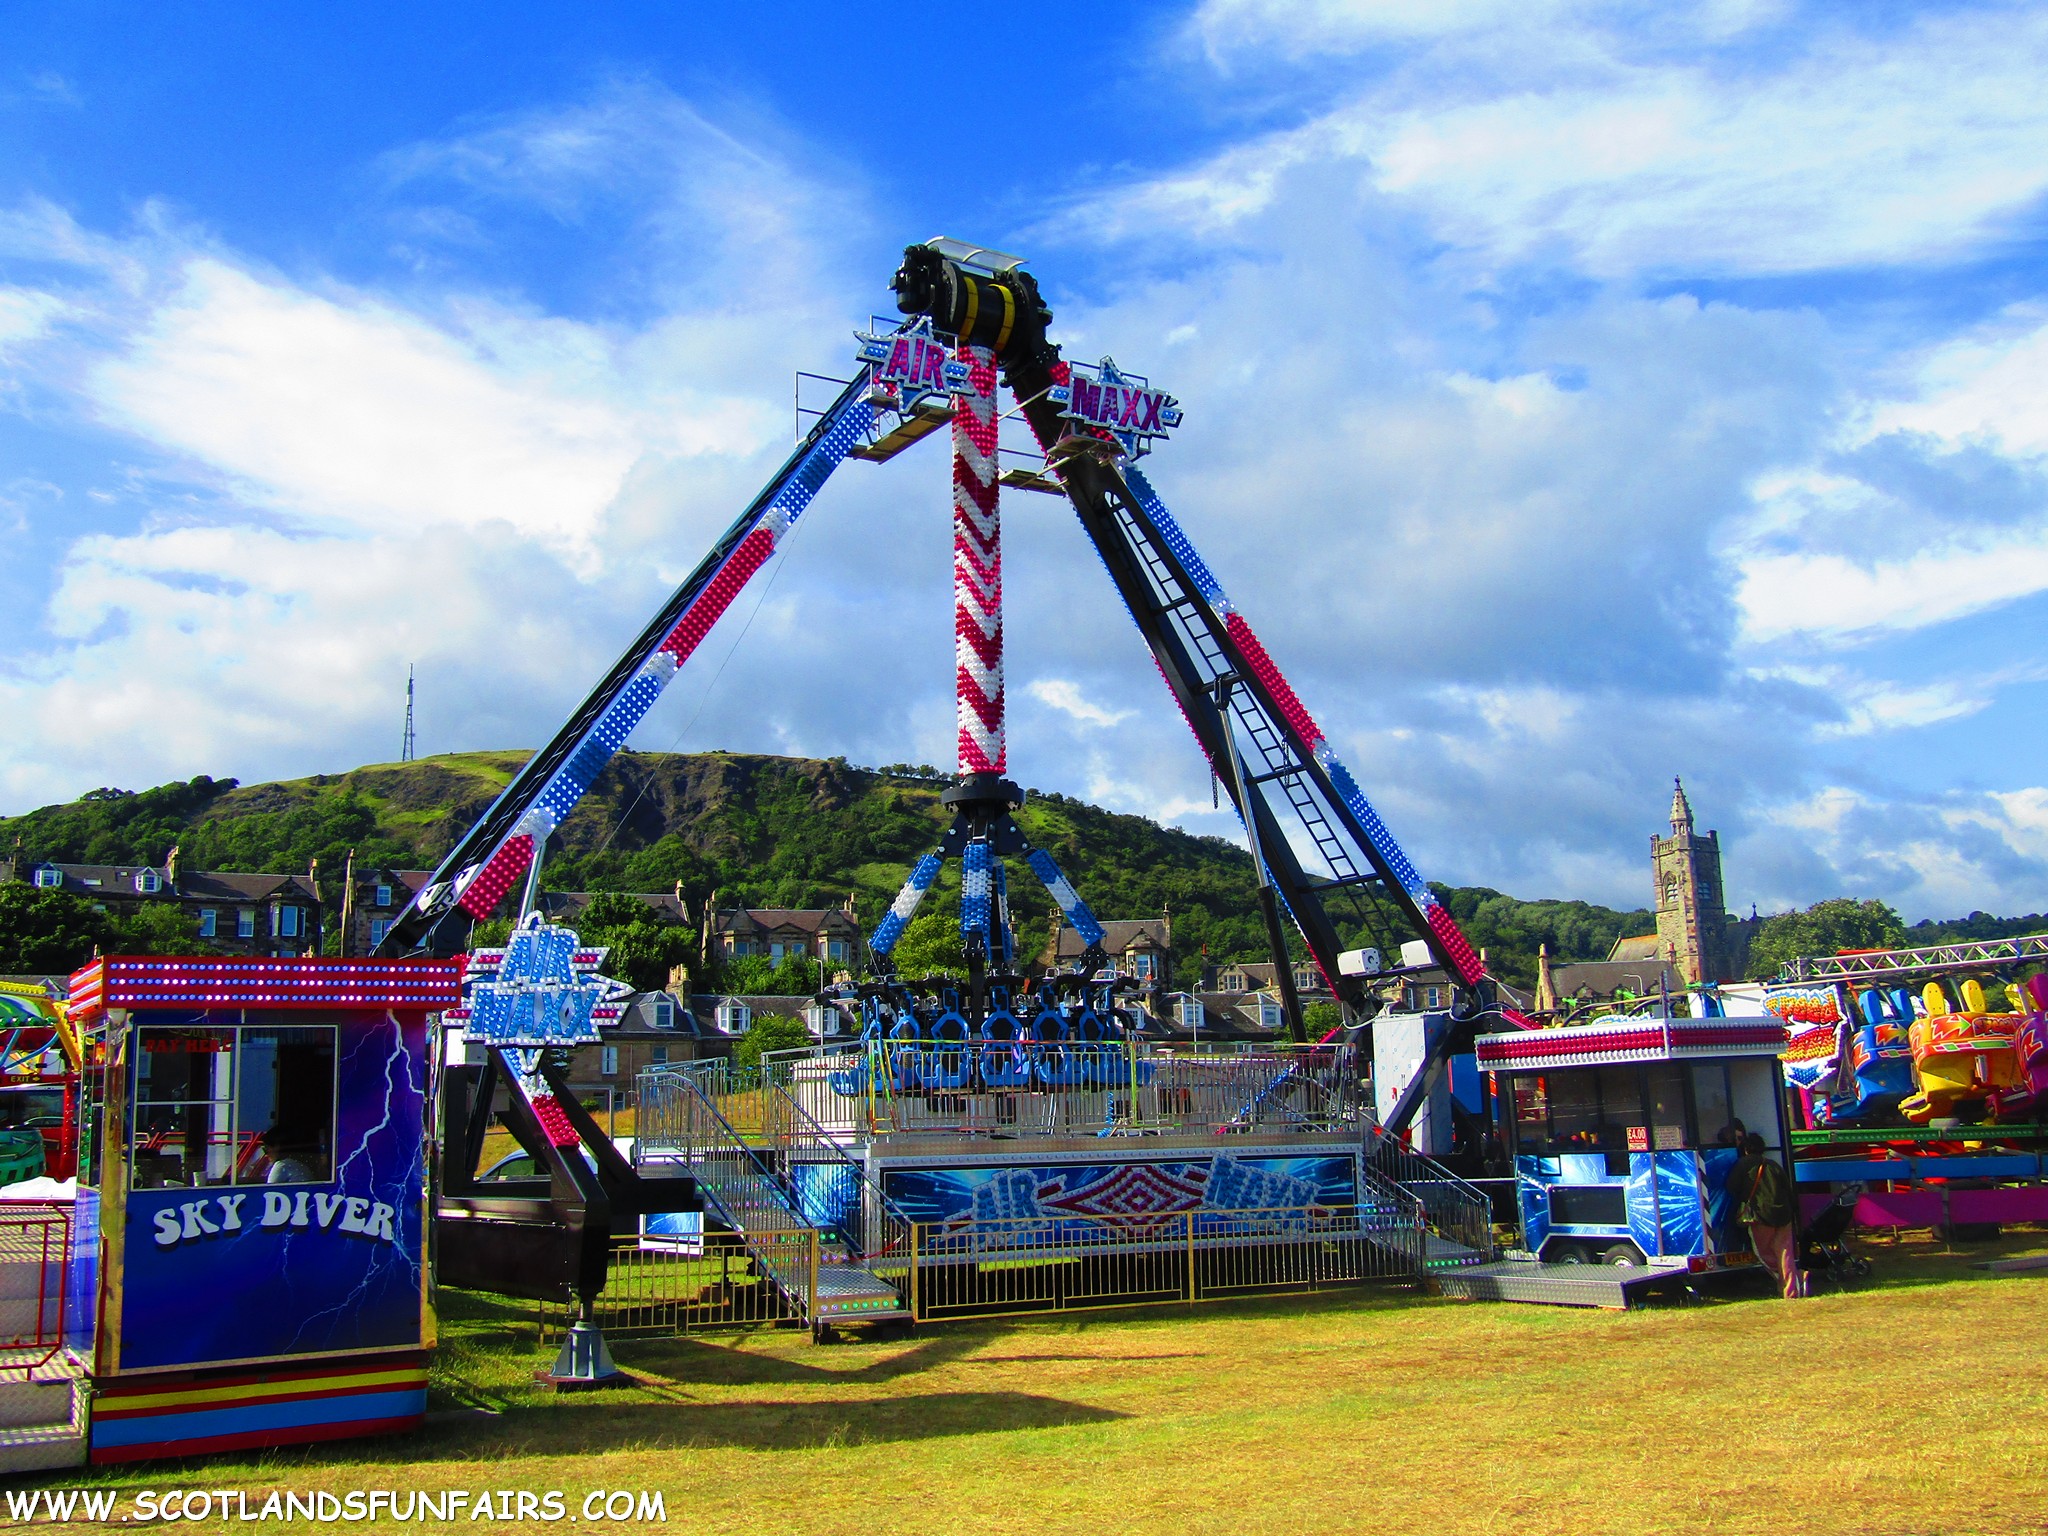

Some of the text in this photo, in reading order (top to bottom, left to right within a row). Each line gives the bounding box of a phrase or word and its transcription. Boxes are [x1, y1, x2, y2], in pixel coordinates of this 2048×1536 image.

[887, 337, 945, 391] AIR
[1072, 377, 1164, 432] MAXX
[502, 930, 575, 984] AIR
[469, 988, 600, 1039] MAXX
[10, 1075, 30, 1083] EXIT
[1628, 1128, 1646, 1140] £4.00
[152, 1190, 395, 1246] SKY DIVER
